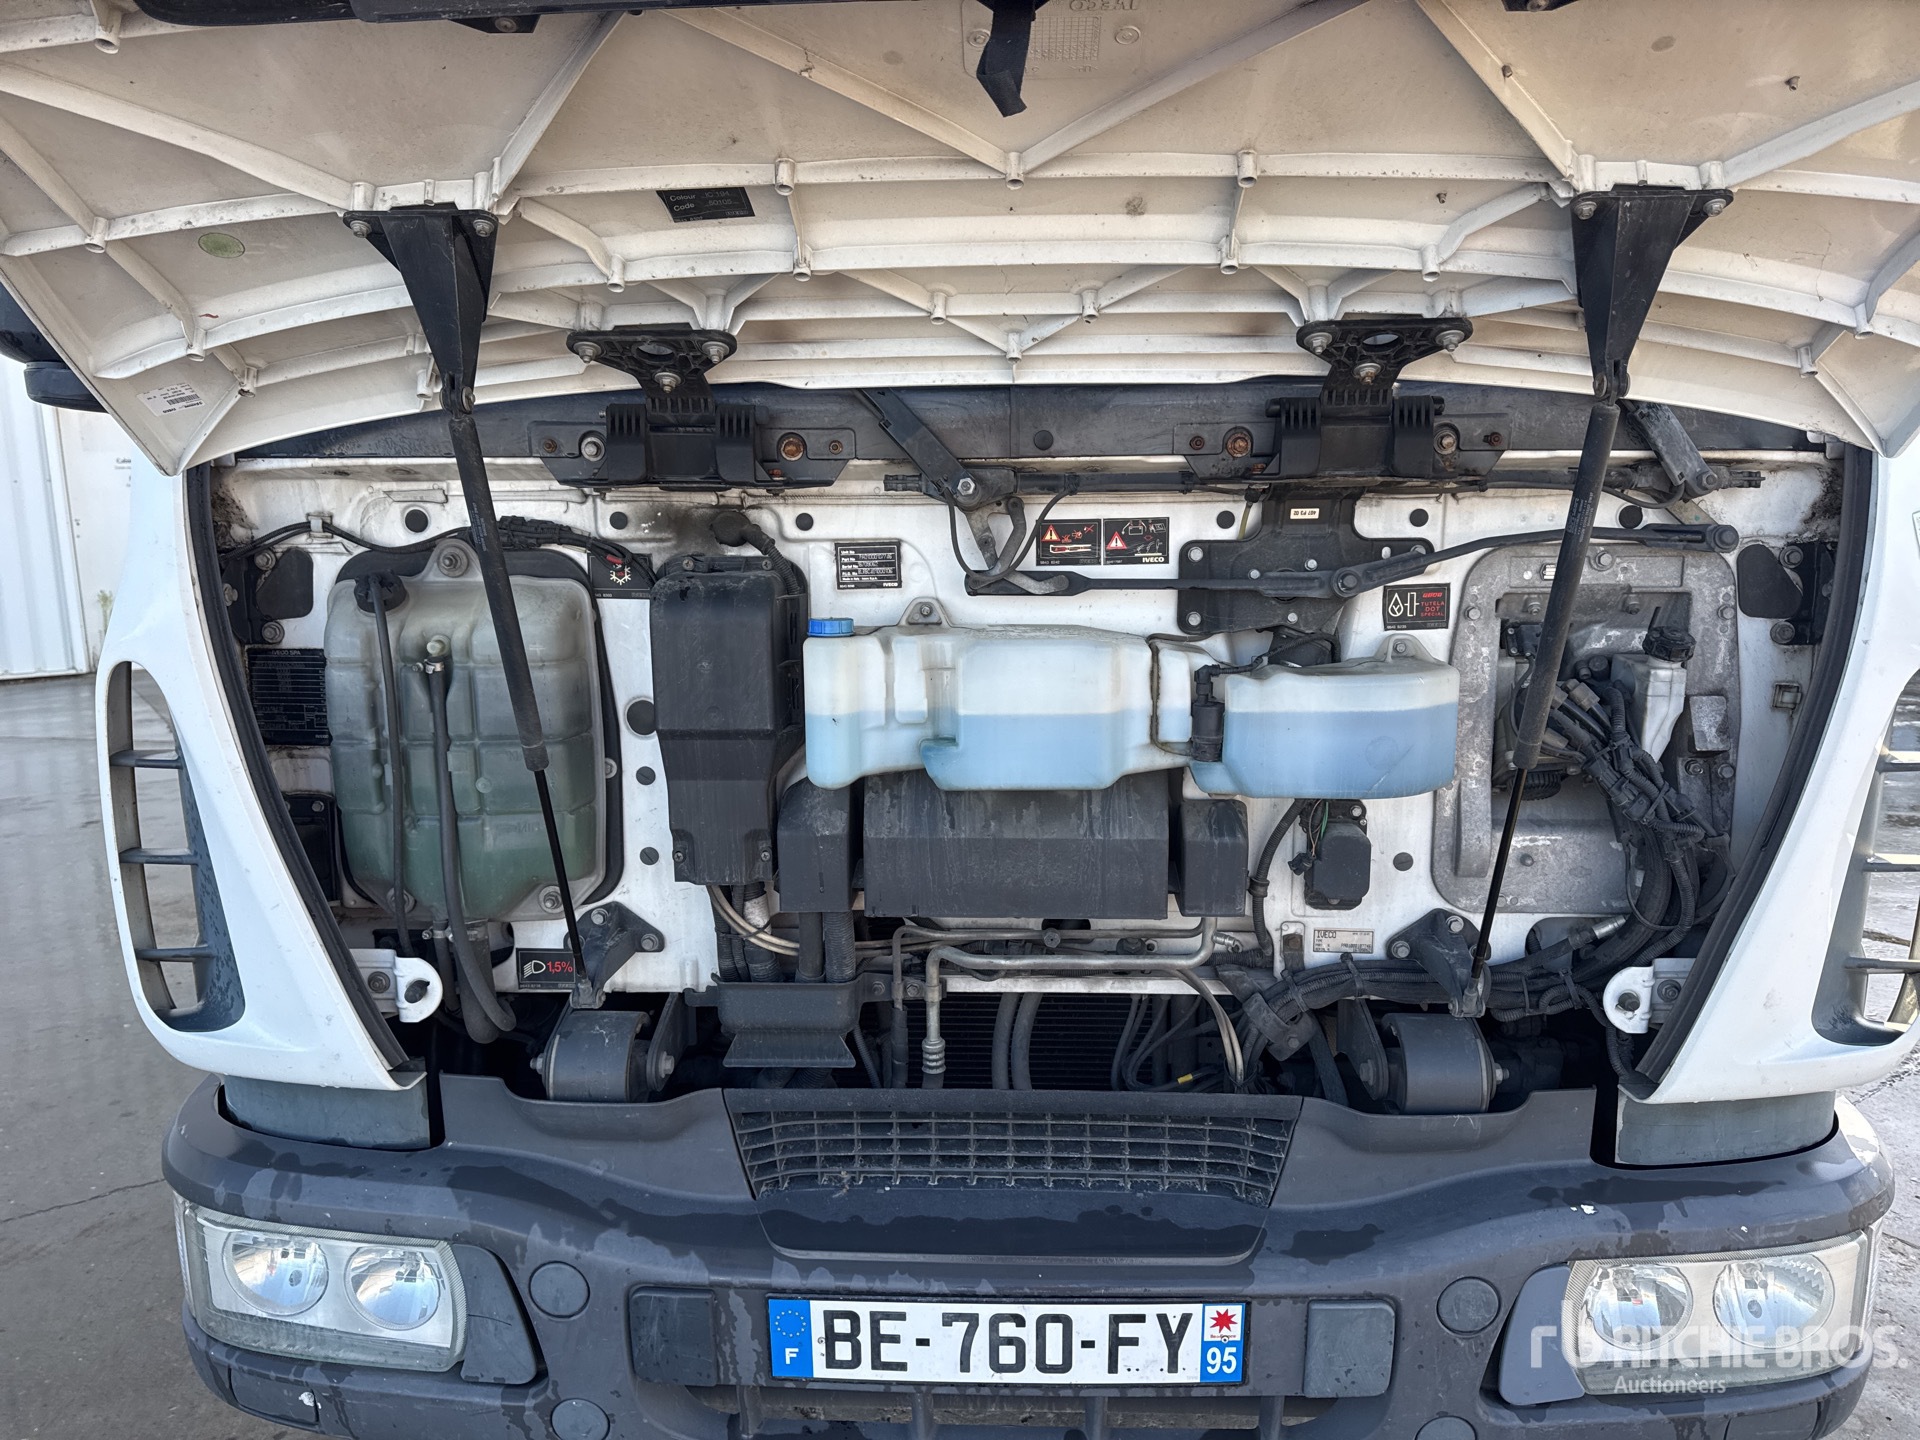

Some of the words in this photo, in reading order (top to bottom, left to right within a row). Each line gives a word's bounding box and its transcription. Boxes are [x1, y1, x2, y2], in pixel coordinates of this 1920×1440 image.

[669, 194, 697, 202] Colour
[673, 202, 695, 212] Code
[1316, 930, 1337, 939] IVECO
[546, 960, 573, 974] 1,5%
[822, 1309, 1193, 1375] BE-760-FY
[785, 1348, 799, 1364] F
[1206, 1346, 1237, 1374] 95
